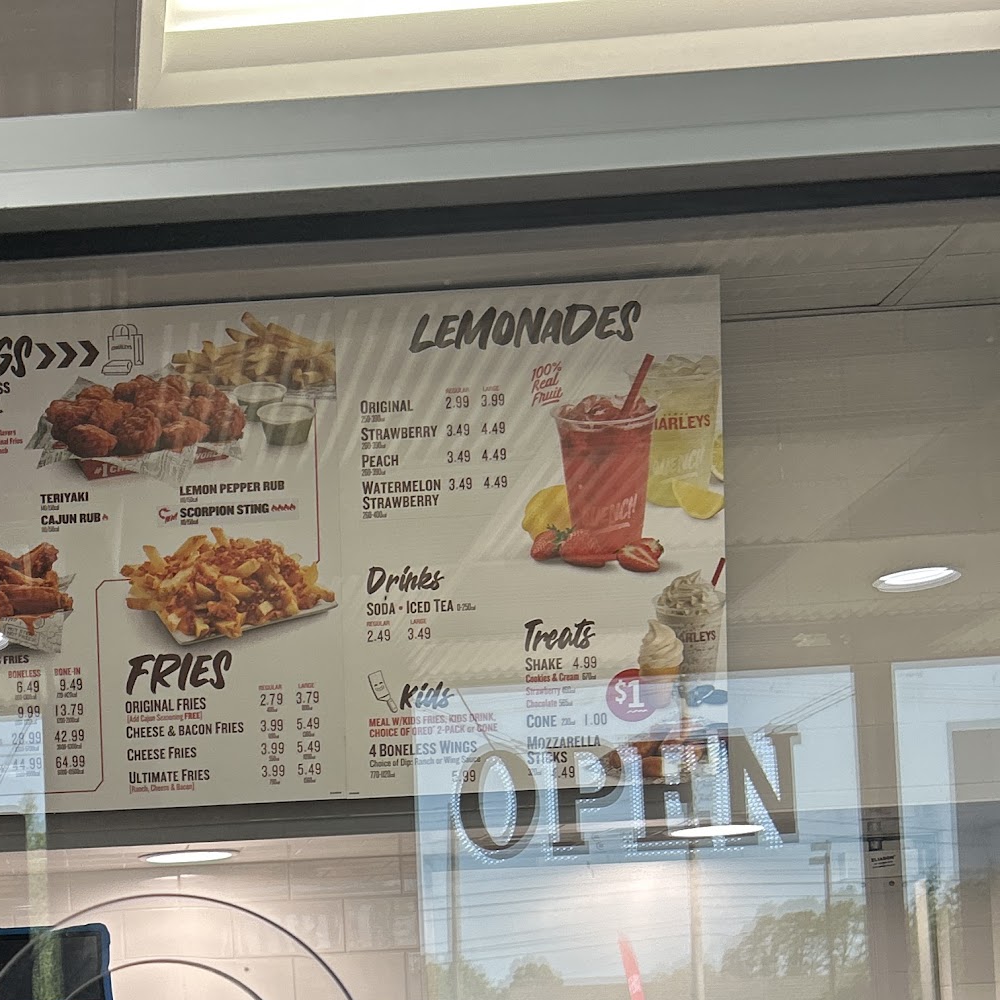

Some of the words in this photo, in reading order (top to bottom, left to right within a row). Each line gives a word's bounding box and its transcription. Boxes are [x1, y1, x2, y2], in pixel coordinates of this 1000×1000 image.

[409, 301, 641, 353] LEMONADES
[532, 361, 562, 381] 100%
[532, 375, 559, 392] Real
[445, 396, 469, 409] 2.99
[481, 394, 504, 407] 3.99
[532, 387, 563, 406] Fruit
[447, 424, 470, 436] 3.49
[482, 422, 505, 434] 4.49
[447, 451, 470, 463] 3.49
[482, 448, 506, 461] 4.49
[180, 485, 217, 496] LEMON
[220, 482, 261, 493] PEPPER
[263, 480, 284, 491] RUB
[449, 478, 472, 491] 3.49
[484, 475, 508, 488] 4.49
[180, 506, 234, 518] SCORPION
[237, 504, 269, 514] STING
[367, 566, 444, 594] Drinks
[367, 602, 395, 616] SODA
[407, 601, 430, 613] ICED
[434, 599, 453, 612] TEA
[367, 629, 391, 642] 2.49
[408, 627, 431, 640] 3.49
[524, 619, 595, 651] Treats
[126, 650, 232, 695] FRIES
[526, 674, 550, 683] Cookies
[552, 674, 557, 682] &
[559, 673, 579, 681] Cream
[17, 681, 39, 693] 6.49
[60, 679, 82, 691] 9.49
[615, 680, 644, 708] $1
[126, 699, 174, 713] ORIGINAL
[177, 697, 206, 711] FRIES
[260, 693, 283, 706] 2.79
[296, 691, 319, 704] 3.79
[400, 681, 454, 710] Kids
[261, 742, 284, 755] 3.99
[297, 740, 320, 753] 5.49
